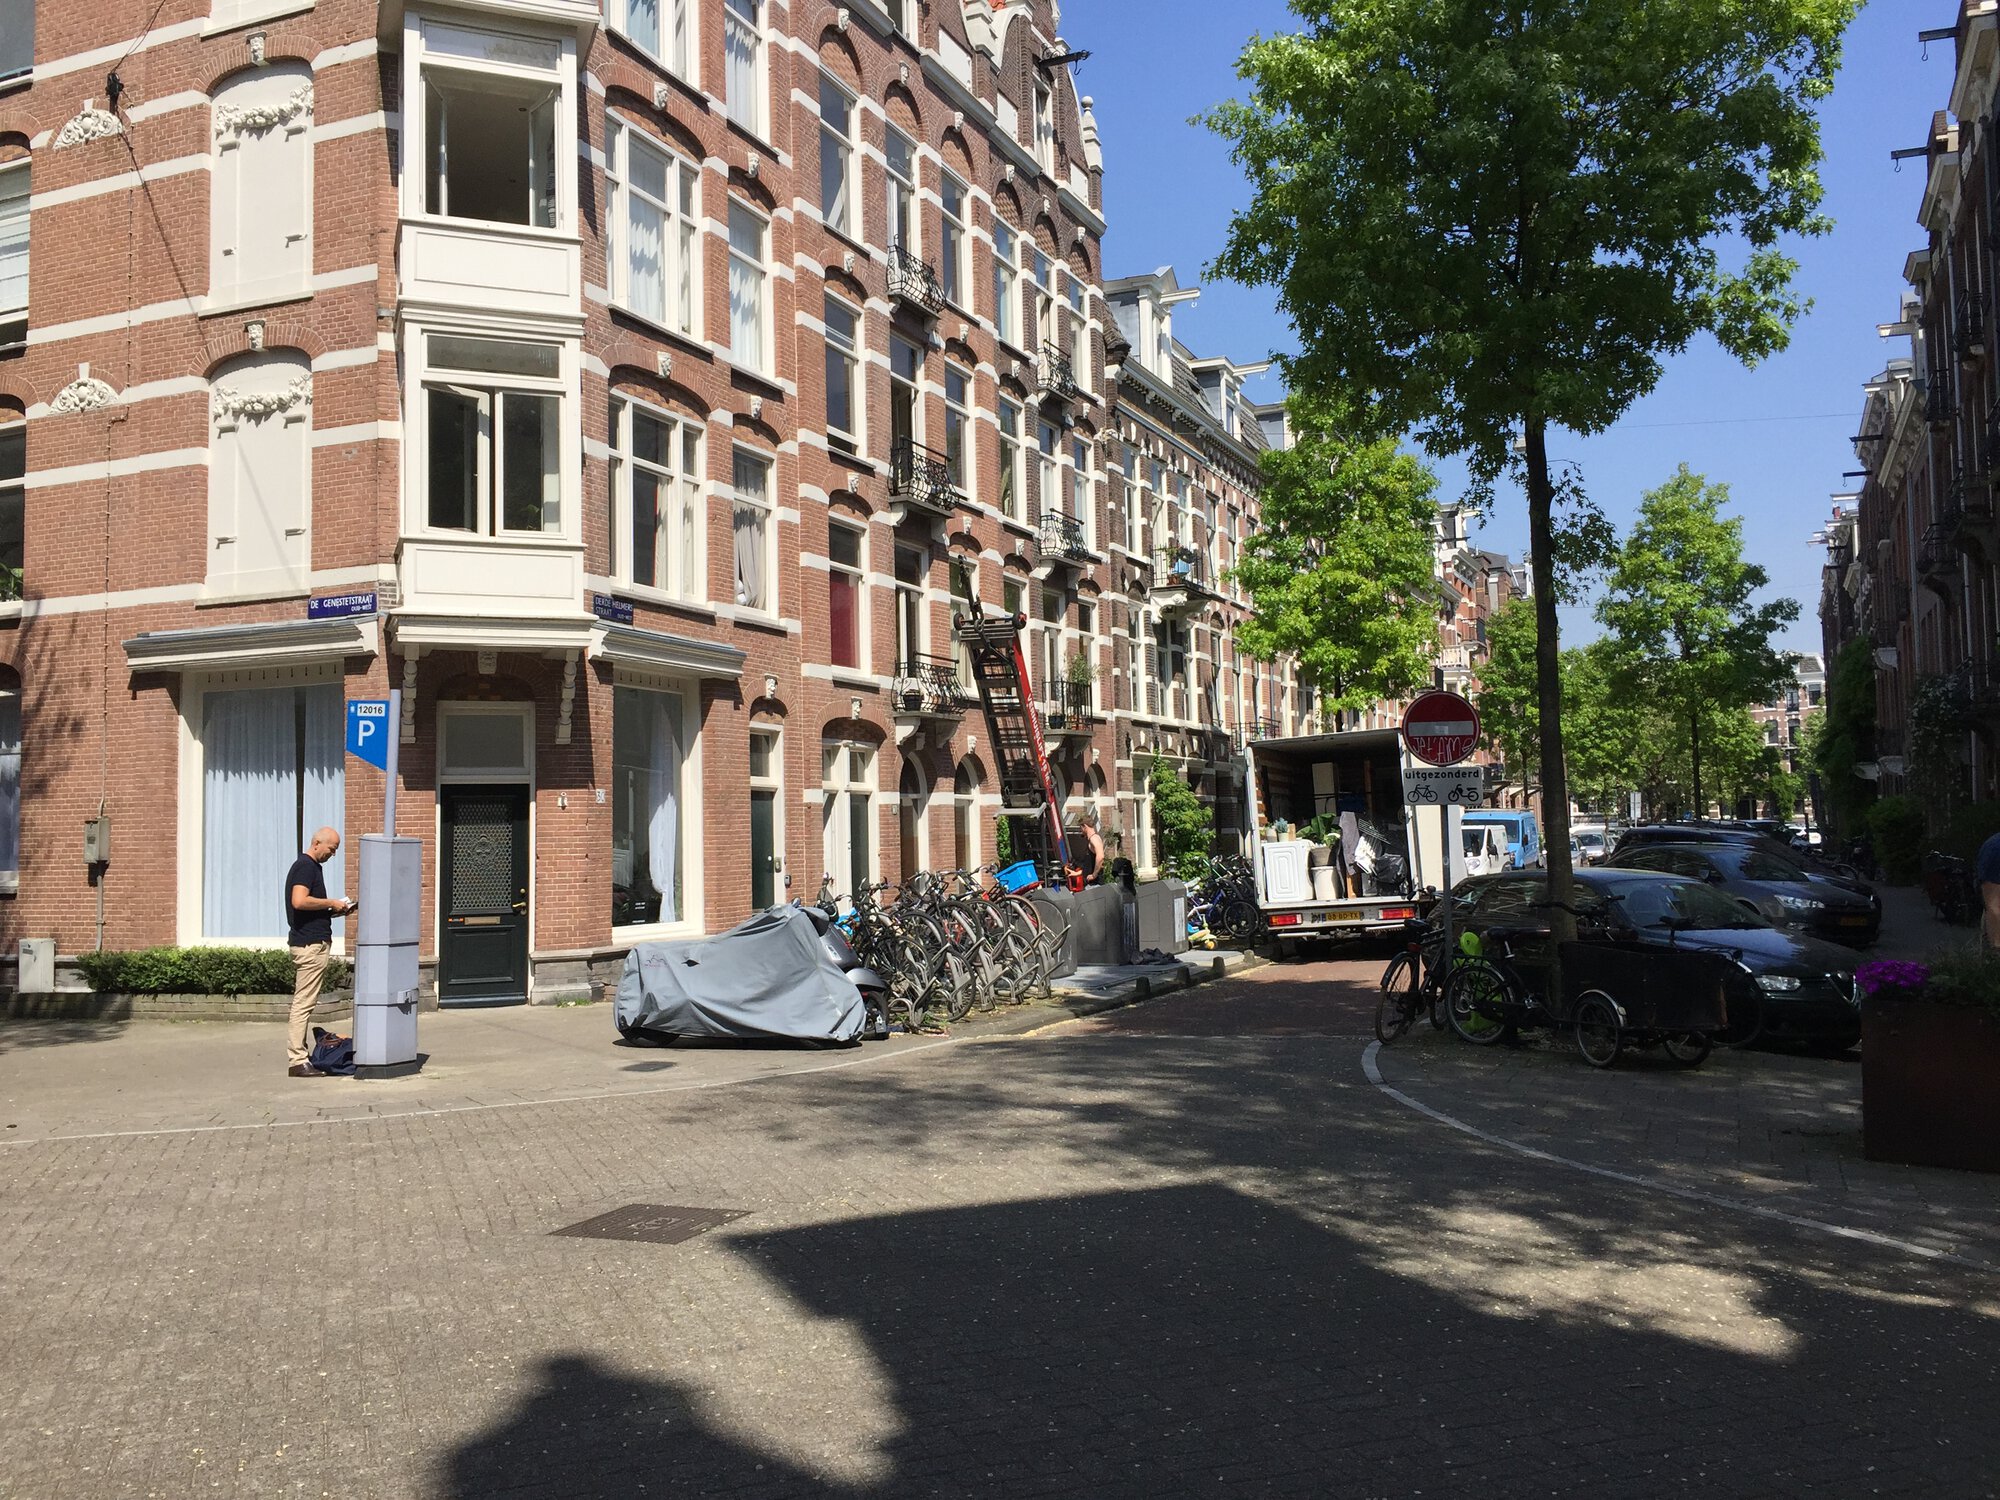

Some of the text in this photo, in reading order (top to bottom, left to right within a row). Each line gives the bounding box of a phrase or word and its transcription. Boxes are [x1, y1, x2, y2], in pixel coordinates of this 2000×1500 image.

[310, 594, 373, 609] DE GENESTETSTRAAT
[612, 600, 633, 611] HELMERS
[595, 607, 612, 617] STRAAT
[358, 706, 383, 714] 12016
[358, 720, 376, 747] P
[1405, 769, 1479, 781] uitgezonderd
